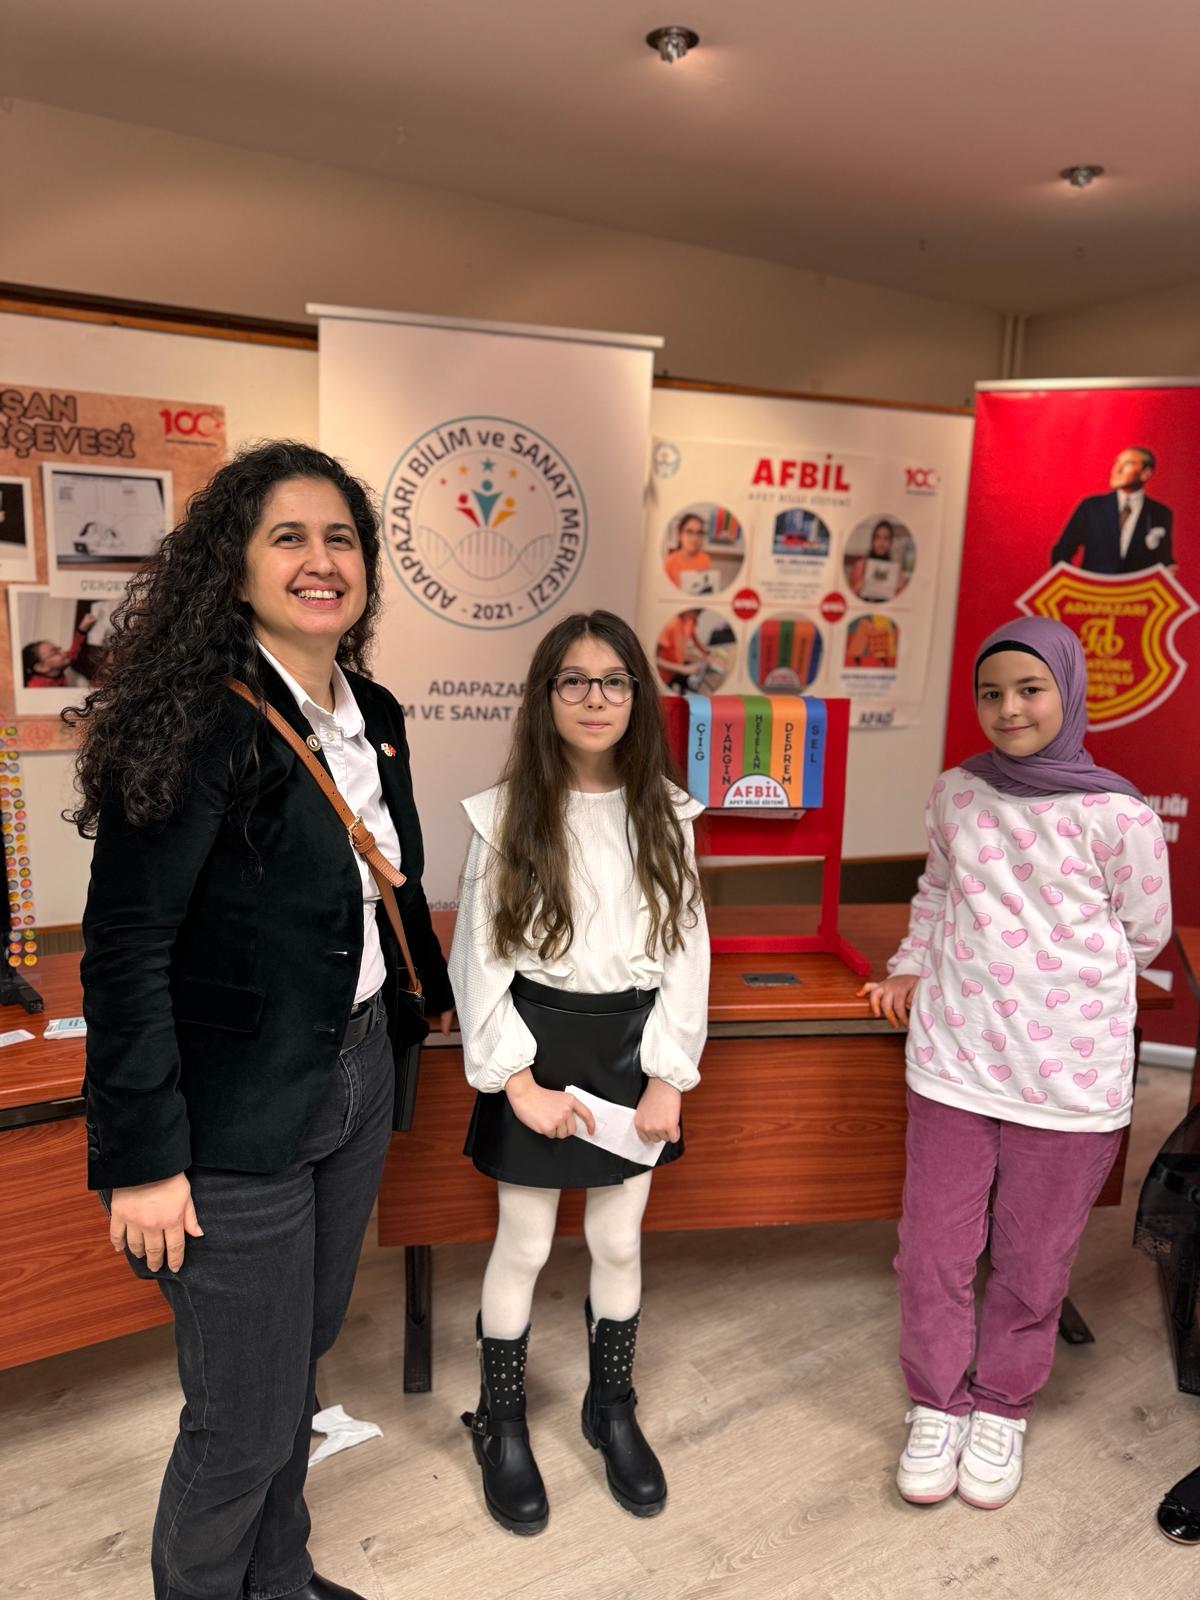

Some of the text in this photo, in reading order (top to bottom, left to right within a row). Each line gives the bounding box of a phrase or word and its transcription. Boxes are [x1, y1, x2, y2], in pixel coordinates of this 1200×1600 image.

[750, 453, 851, 493] AFBİL
[391, 427, 581, 612] ADAPAZARI BİLİM ve SANAT MERKEZİ
[472, 602, 513, 620] 2021
[420, 704, 445, 720] VE
[450, 704, 512, 721] SANAT
[722, 723, 733, 785] YANGIN
[782, 722, 794, 785] DEPREM
[810, 725, 819, 763] SEL
[732, 781, 781, 798] AFBİL
